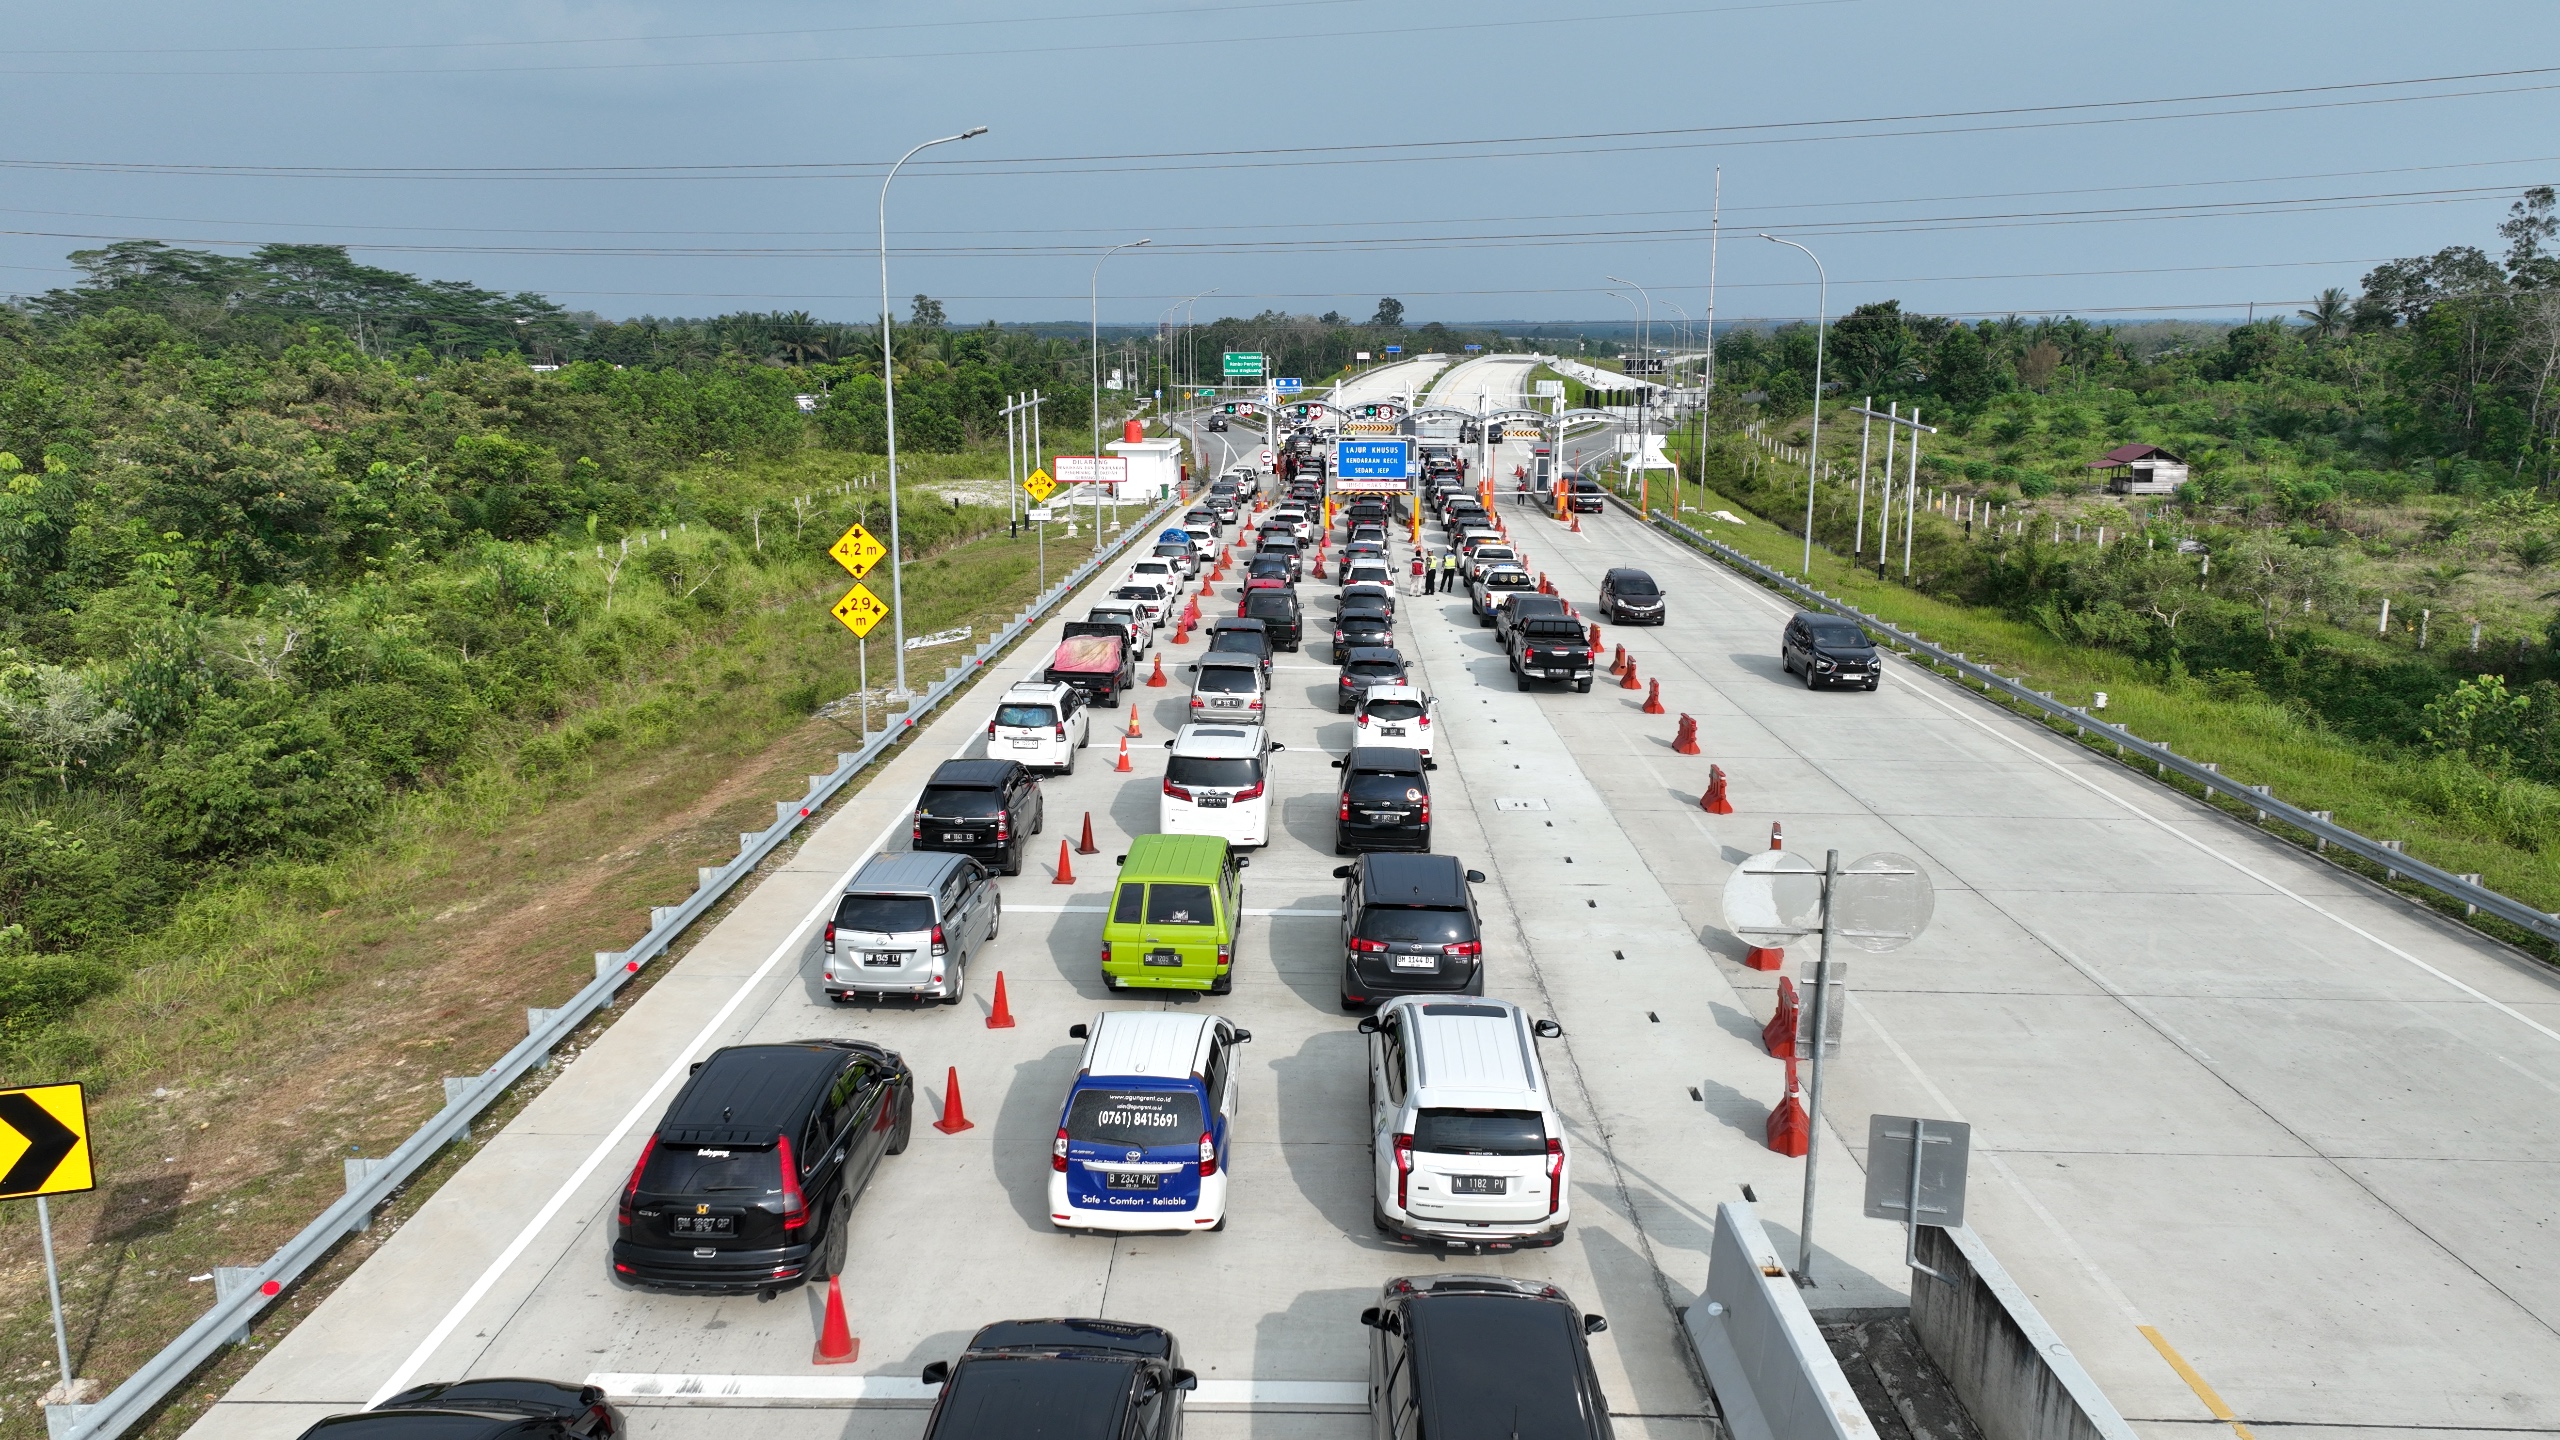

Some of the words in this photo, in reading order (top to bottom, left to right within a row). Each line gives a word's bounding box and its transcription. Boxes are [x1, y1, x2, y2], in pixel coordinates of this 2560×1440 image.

[1345, 446, 1367, 454] LAJUR
[1371, 446, 1399, 454] KHUSUS
[1033, 476, 1047, 486] 3,5
[839, 543, 862, 558] 4,2
[866, 545, 877, 555] m
[851, 597, 871, 612] 2,9
[856, 616, 866, 625] m
[1109, 1094, 1171, 1103] www.agungrent.co.id
[1098, 1110, 1132, 1128] (0761)
[1133, 1111, 1178, 1127] 8415691
[1109, 1174, 1115, 1183] B
[1120, 1174, 1140, 1184] 2347
[1141, 1174, 1157, 1184] PKZ
[1456, 1178, 1462, 1188] N
[1469, 1178, 1487, 1188] 1182
[1494, 1179, 1504, 1189] PV
[1082, 1194, 1101, 1204] Safe
[1109, 1196, 1144, 1206] Comfort
[1152, 1196, 1187, 1206] Reliable
